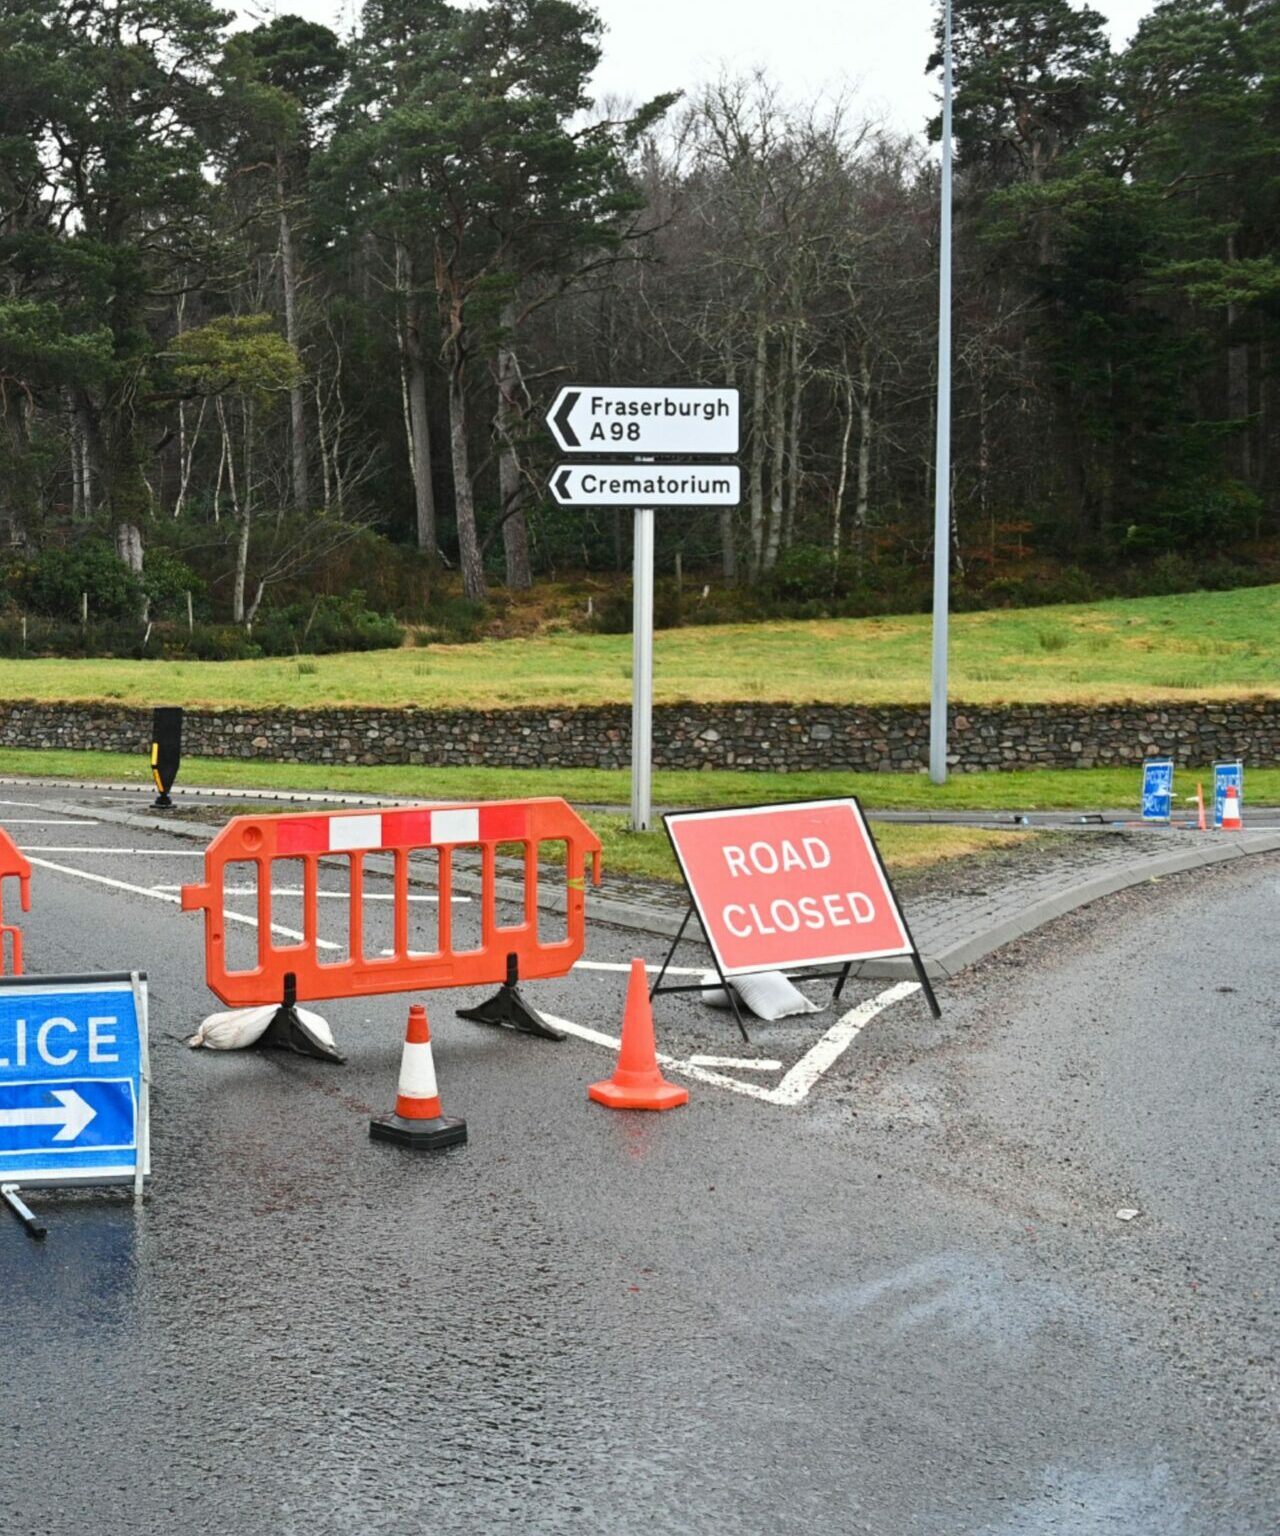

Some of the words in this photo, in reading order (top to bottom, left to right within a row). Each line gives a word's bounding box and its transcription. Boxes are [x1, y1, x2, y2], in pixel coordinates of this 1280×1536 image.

[591, 396, 730, 420] Fraserburgh
[590, 422, 641, 441] A98
[581, 474, 730, 494] Crematorium
[722, 837, 832, 877] ROAD
[722, 891, 876, 938] CLOSED
